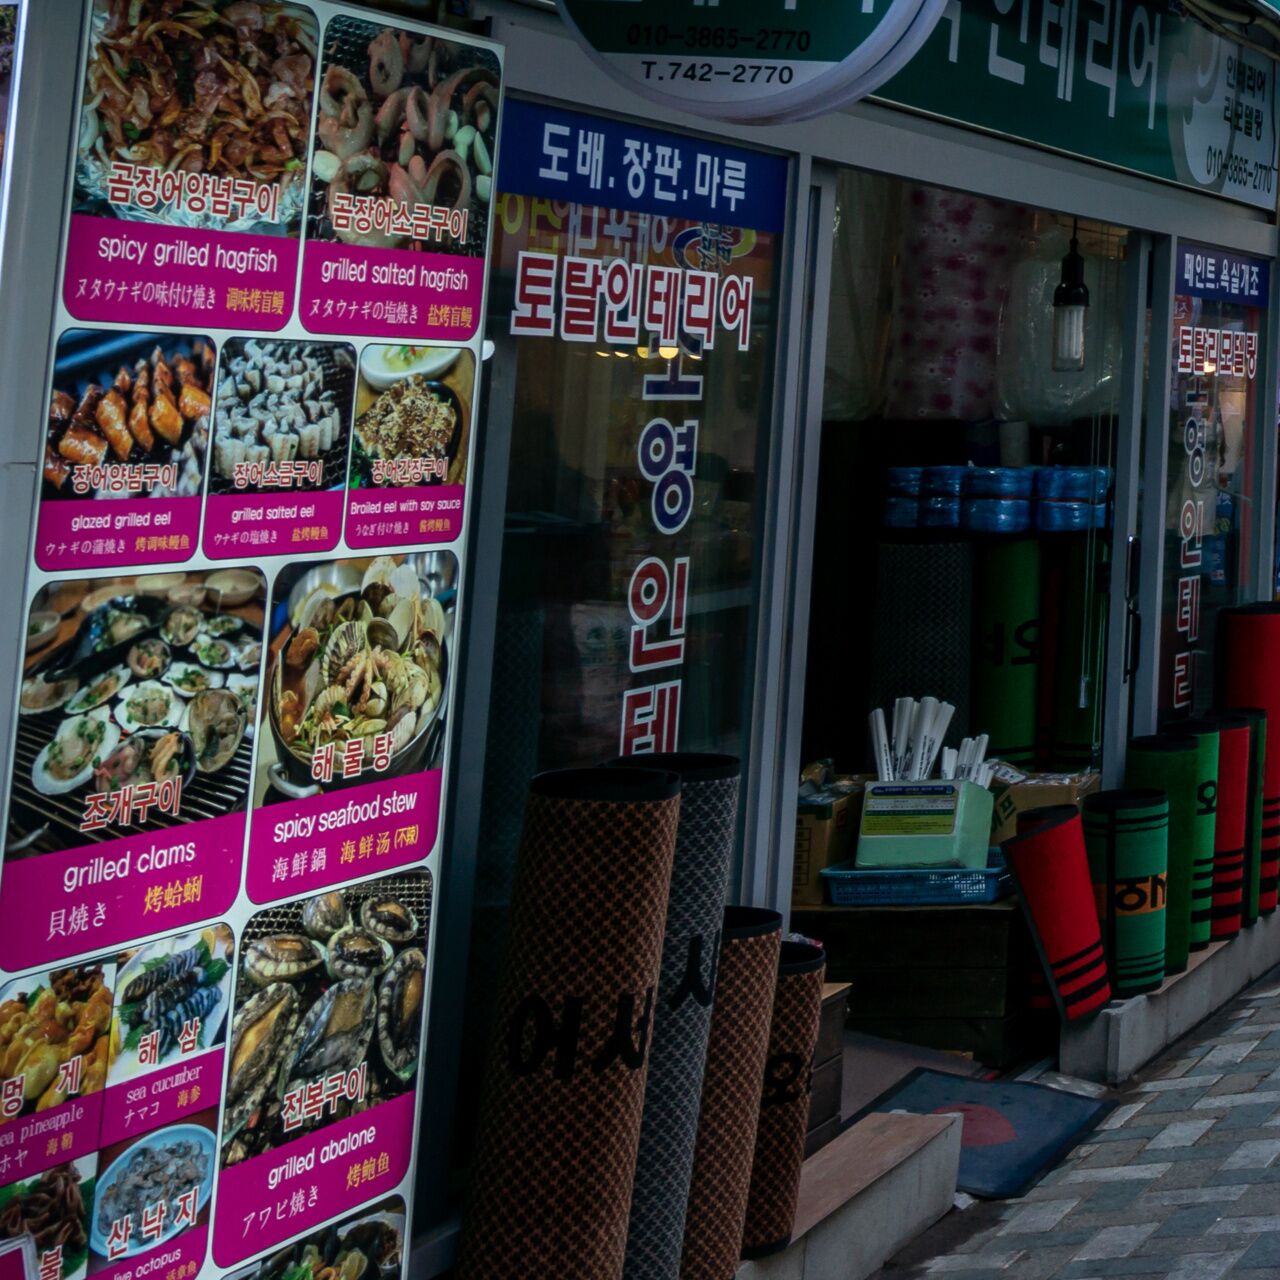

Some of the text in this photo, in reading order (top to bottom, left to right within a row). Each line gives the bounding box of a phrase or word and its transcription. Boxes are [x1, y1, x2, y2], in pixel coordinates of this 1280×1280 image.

[626, 22, 812, 52] 010-3865-2770
[641, 60, 794, 85] T.742-2770
[106, 162, 280, 222] 곰장어양념구이
[331, 192, 470, 246] 곰장어소금구이
[98, 234, 279, 275] spicy grilled hagfish
[320, 258, 470, 293] grilled salted hagfish
[510, 250, 754, 352] 토탈인테리어
[71, 461, 180, 494] 장어양념구이
[233, 458, 324, 489] 장어소금구이
[114, 510, 151, 530] grilled
[154, 509, 172, 526] eel
[231, 503, 316, 525] grilled salted eel
[383, 499, 398, 514] eel
[399, 497, 418, 513] with
[420, 498, 436, 515] soy
[437, 496, 462, 512] sauce
[310, 730, 396, 784] 해물탕
[79, 775, 184, 833] 조개구이
[273, 789, 418, 844] spicy seafood stew
[63, 839, 196, 893] grilled clams
[138, 1017, 201, 1067] 해삼
[1, 1055, 83, 1119] 멍게
[125, 1064, 203, 1103] sea cucumber
[280, 1060, 369, 1133] 전복구이
[19, 1104, 84, 1142] pineapple
[267, 1123, 377, 1190] grilled abalone
[107, 1185, 199, 1261] 산낙지
[135, 1247, 183, 1277] octopus
